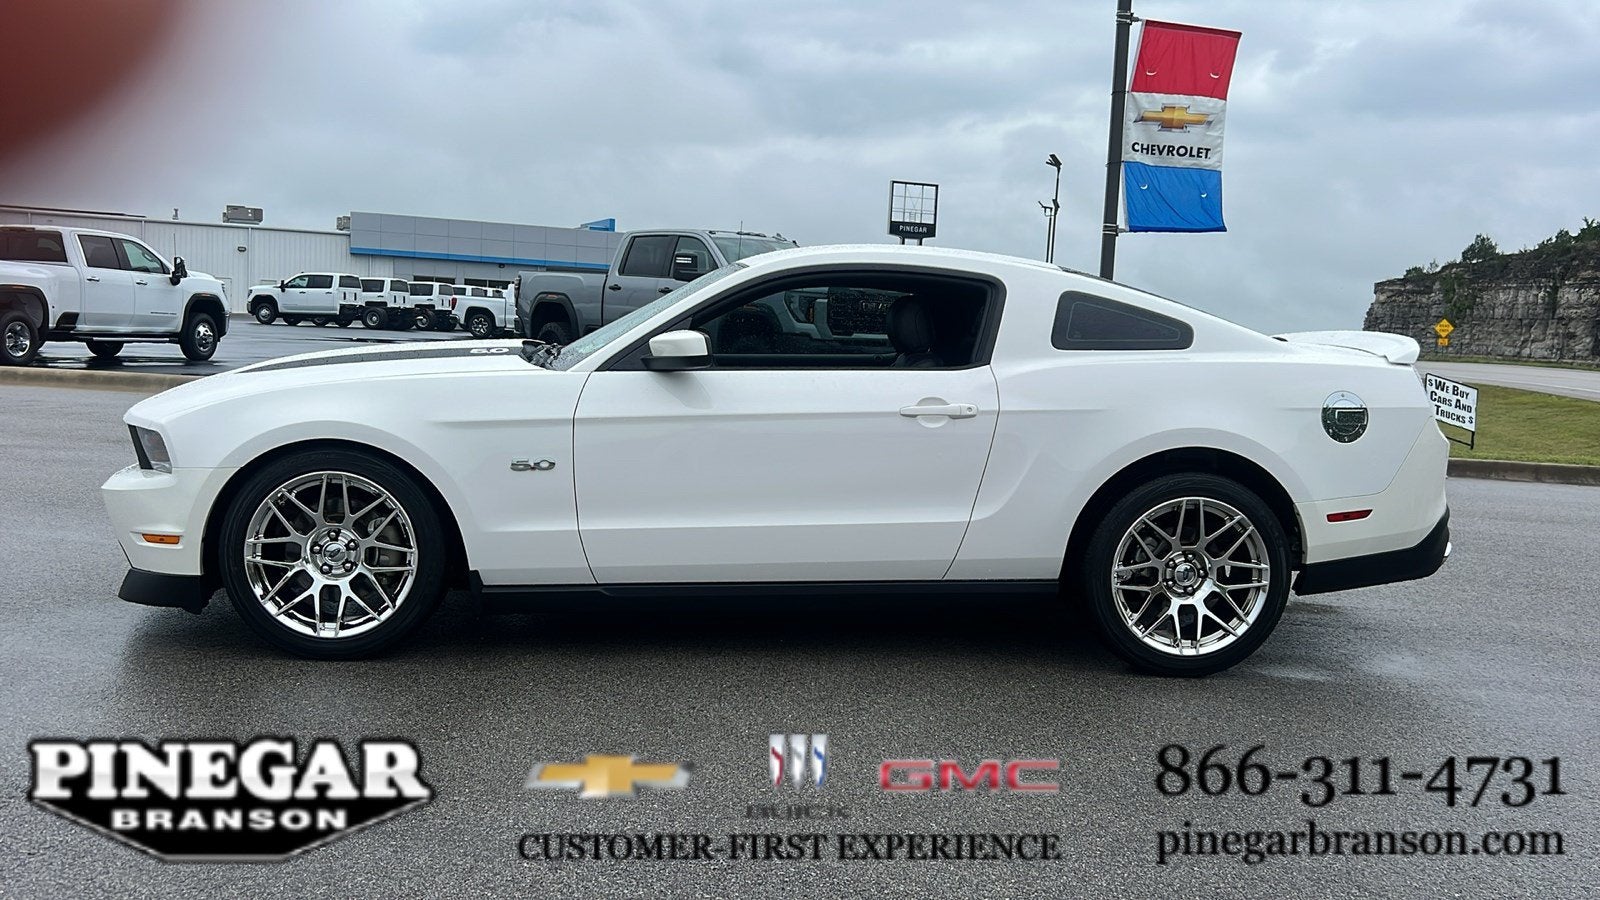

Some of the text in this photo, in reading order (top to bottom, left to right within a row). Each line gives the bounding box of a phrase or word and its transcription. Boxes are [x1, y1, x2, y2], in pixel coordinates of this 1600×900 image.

[1131, 141, 1211, 160] CHEVROLET
[899, 225, 928, 234] PINEGAR
[510, 458, 556, 472] 5.0
